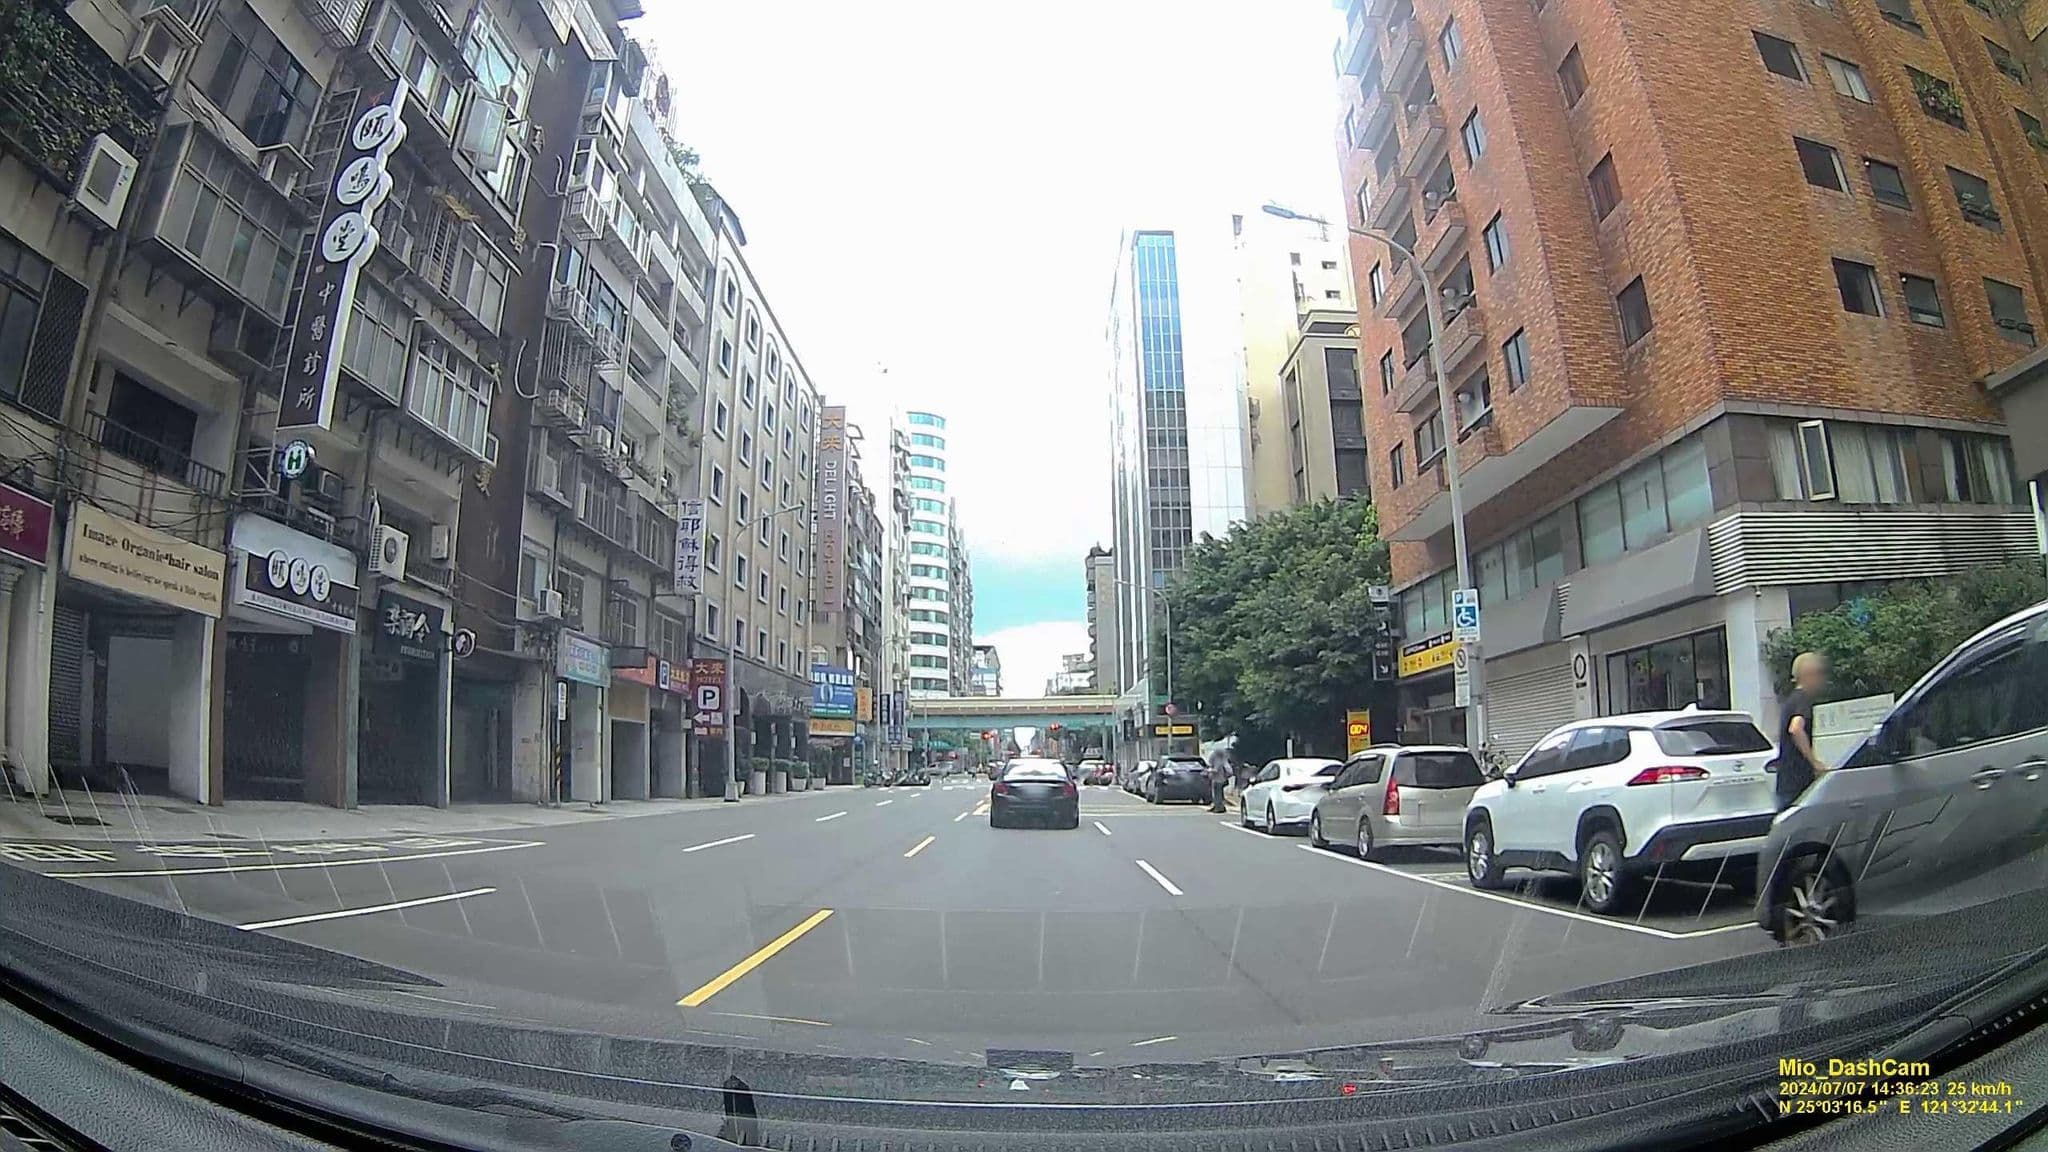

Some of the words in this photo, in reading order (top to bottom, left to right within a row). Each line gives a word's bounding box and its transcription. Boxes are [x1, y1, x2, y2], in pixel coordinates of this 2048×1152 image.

[296, 281, 336, 410] 中醫診所
[825, 461, 837, 521] DELIGHT
[82, 523, 118, 547] Image
[193, 563, 219, 582] salon
[677, 500, 702, 590] 信耶穌得救
[702, 690, 716, 706] P
